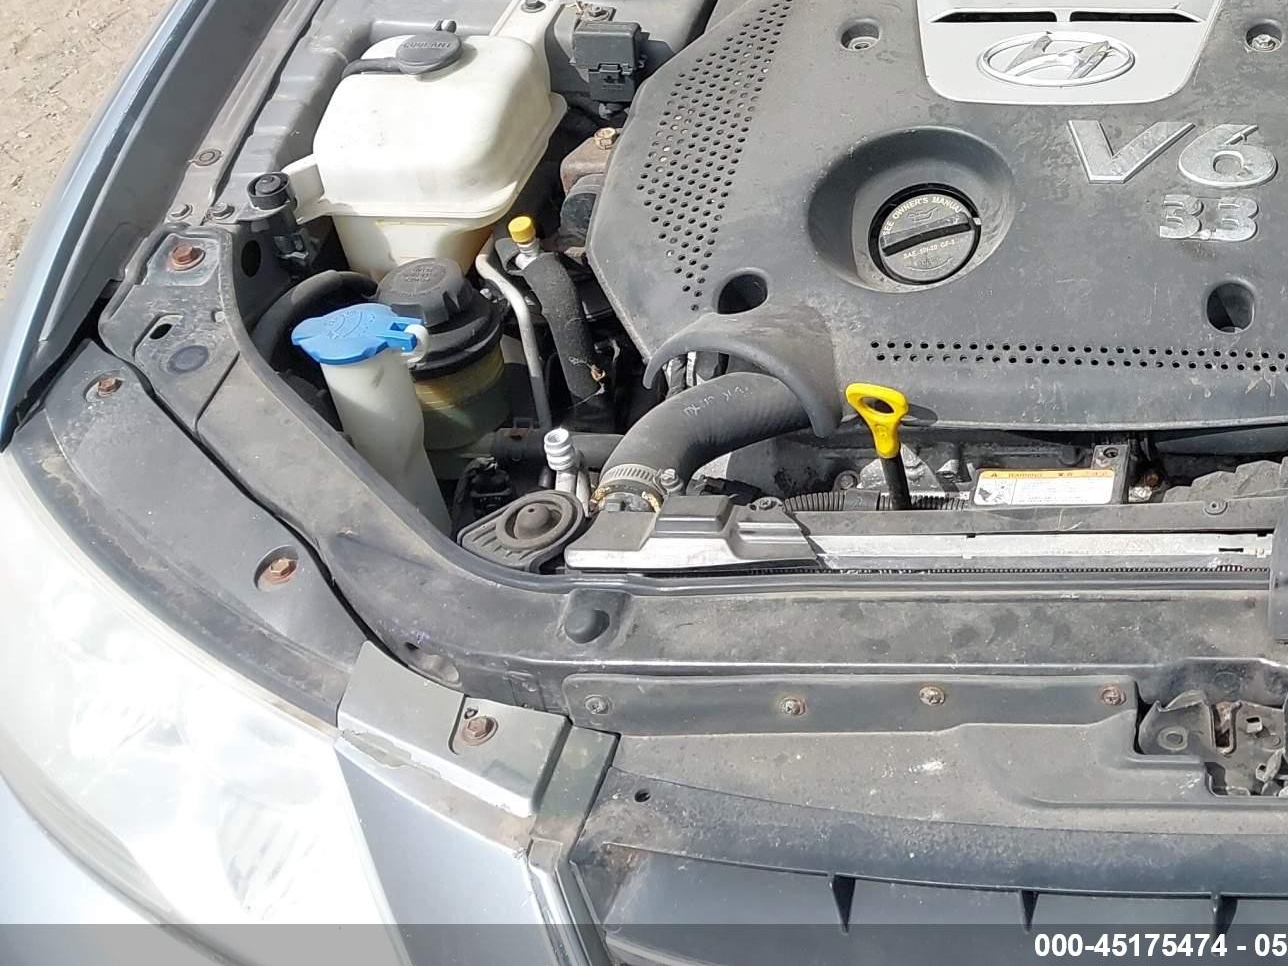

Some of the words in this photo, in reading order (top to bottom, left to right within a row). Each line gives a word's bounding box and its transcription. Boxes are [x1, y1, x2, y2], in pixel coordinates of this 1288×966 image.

[1068, 120, 1277, 188] V6
[883, 221, 895, 235] SEE
[892, 197, 929, 219] OWNER'S
[1160, 194, 1258, 241] 3.3
